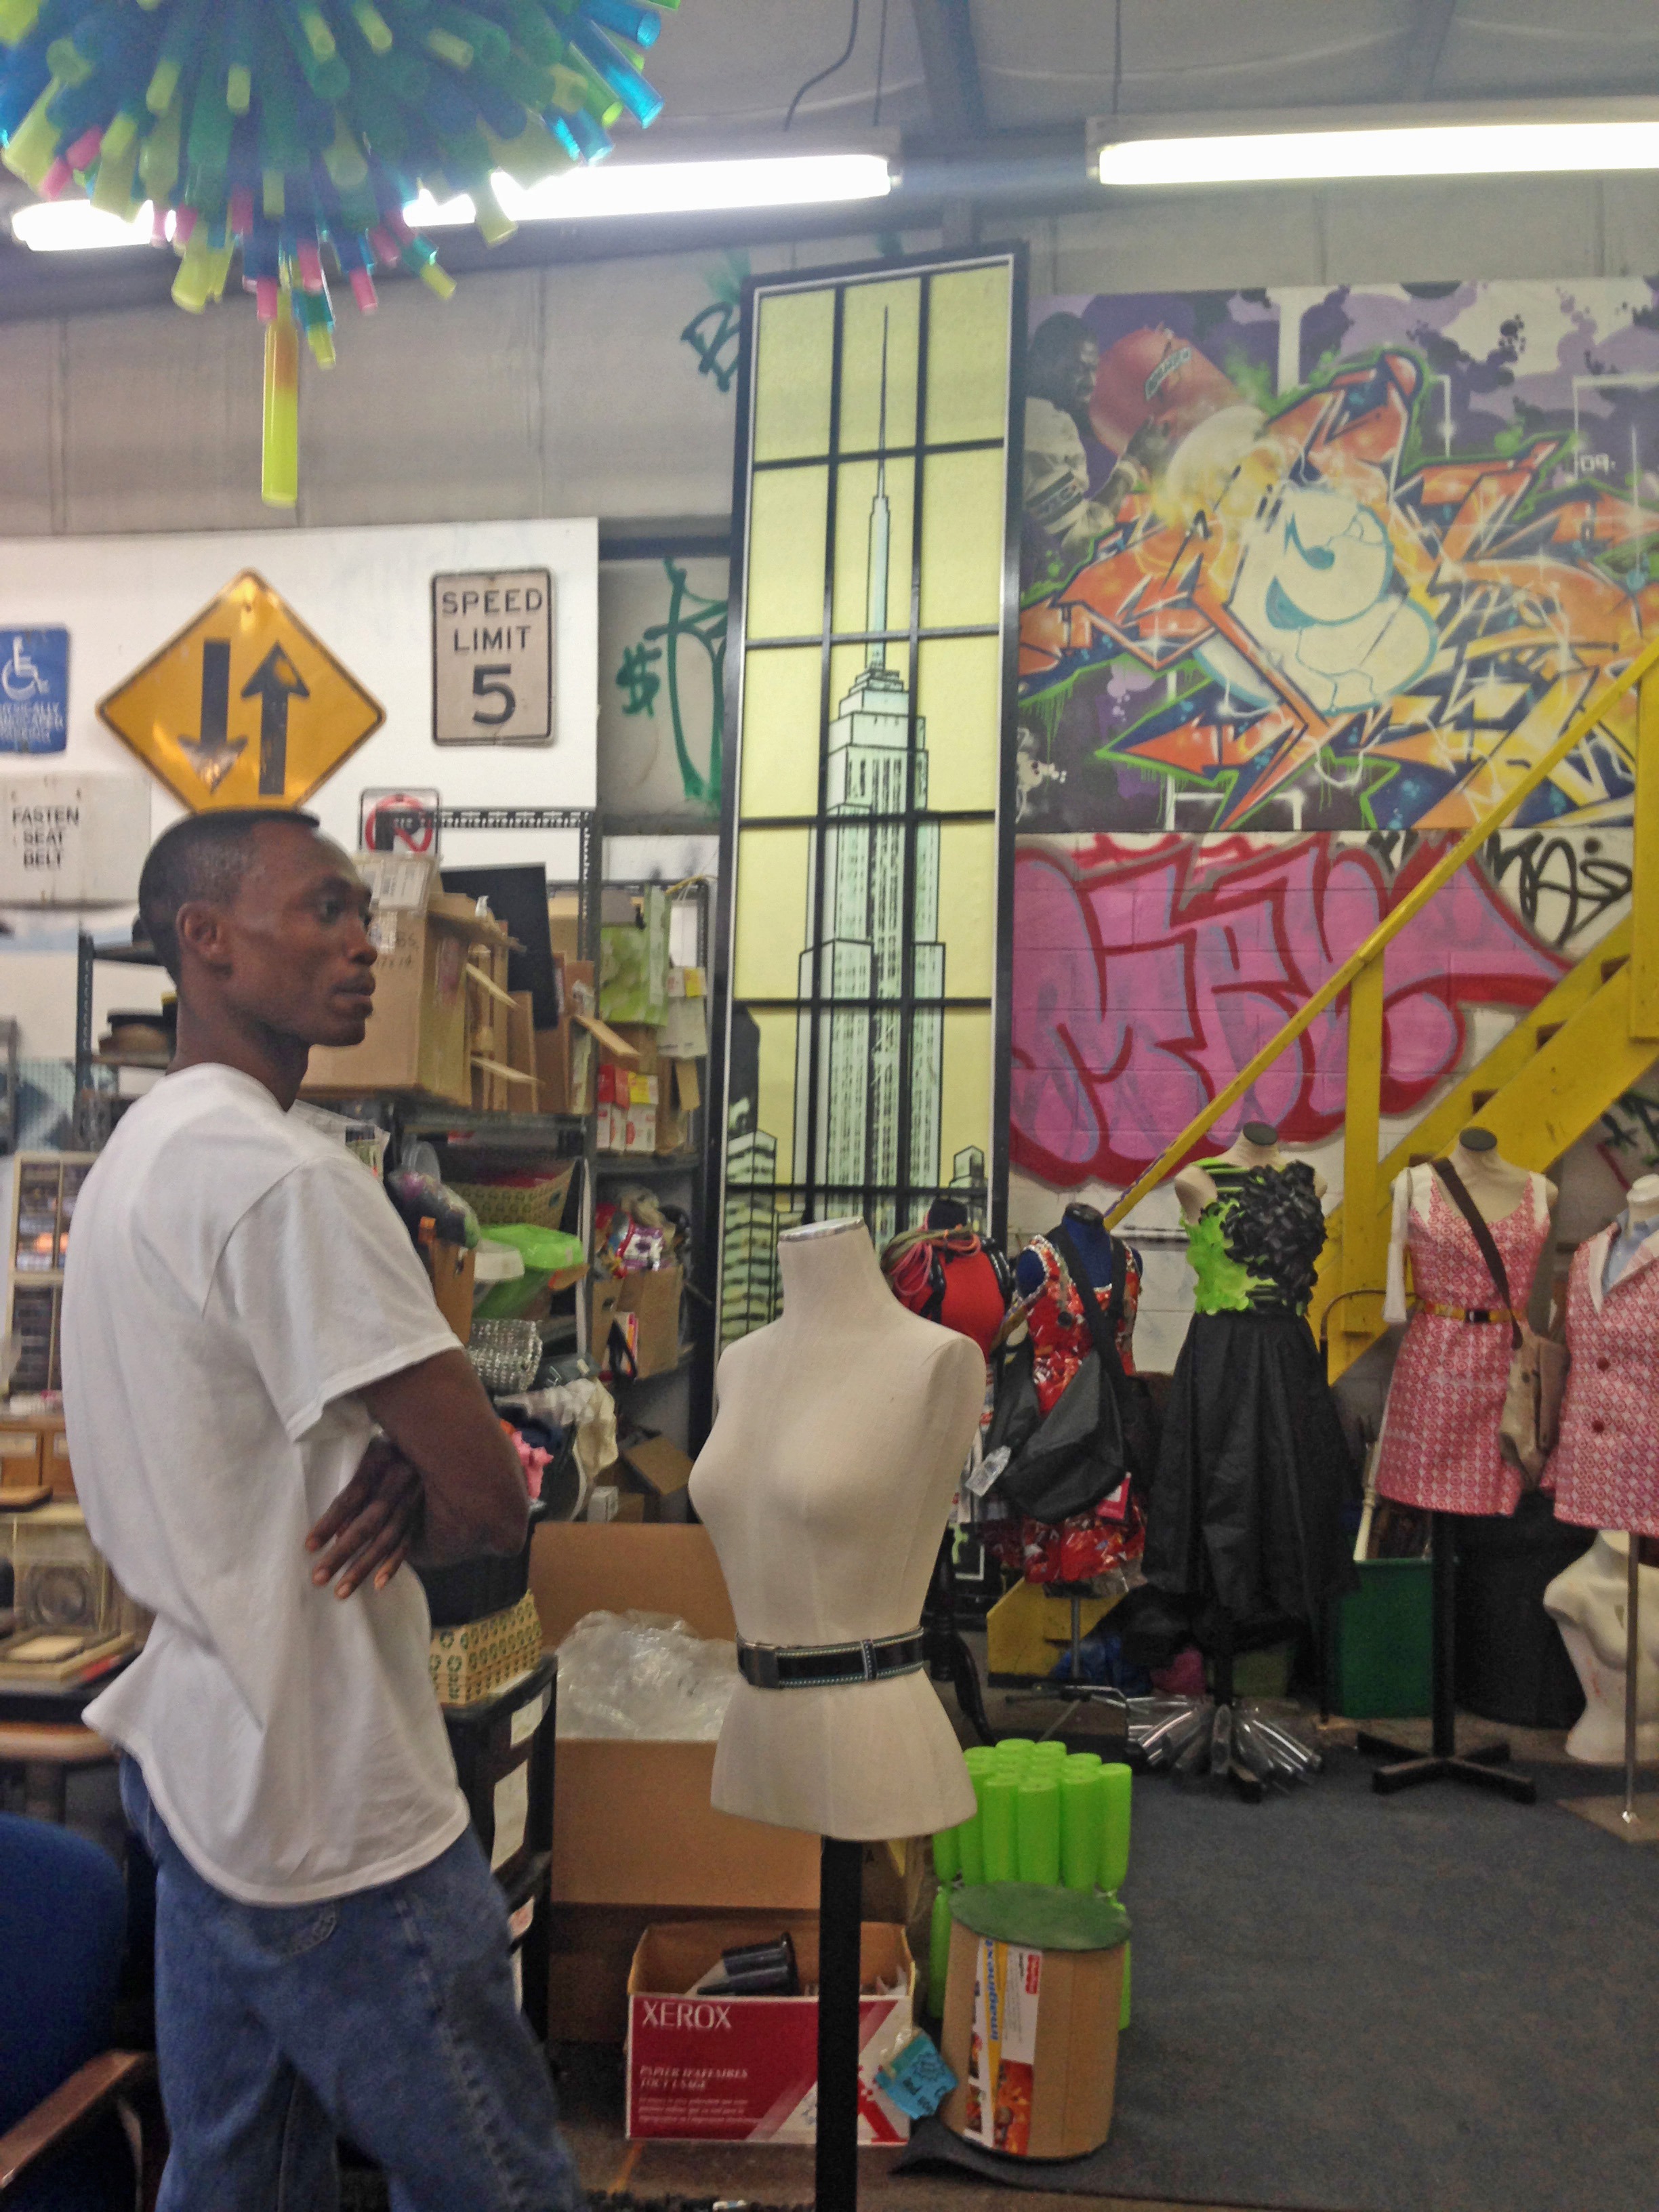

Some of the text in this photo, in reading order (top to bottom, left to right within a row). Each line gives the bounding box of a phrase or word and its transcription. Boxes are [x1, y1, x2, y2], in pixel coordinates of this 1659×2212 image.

[442, 588, 543, 615] SPEED
[453, 626, 531, 652] LIMIT
[472, 663, 516, 725] 5
[12, 806, 79, 827] FASTEN
[23, 828, 63, 847] SEAT
[23, 848, 62, 869] BELT
[642, 2000, 733, 2030] XEROX
